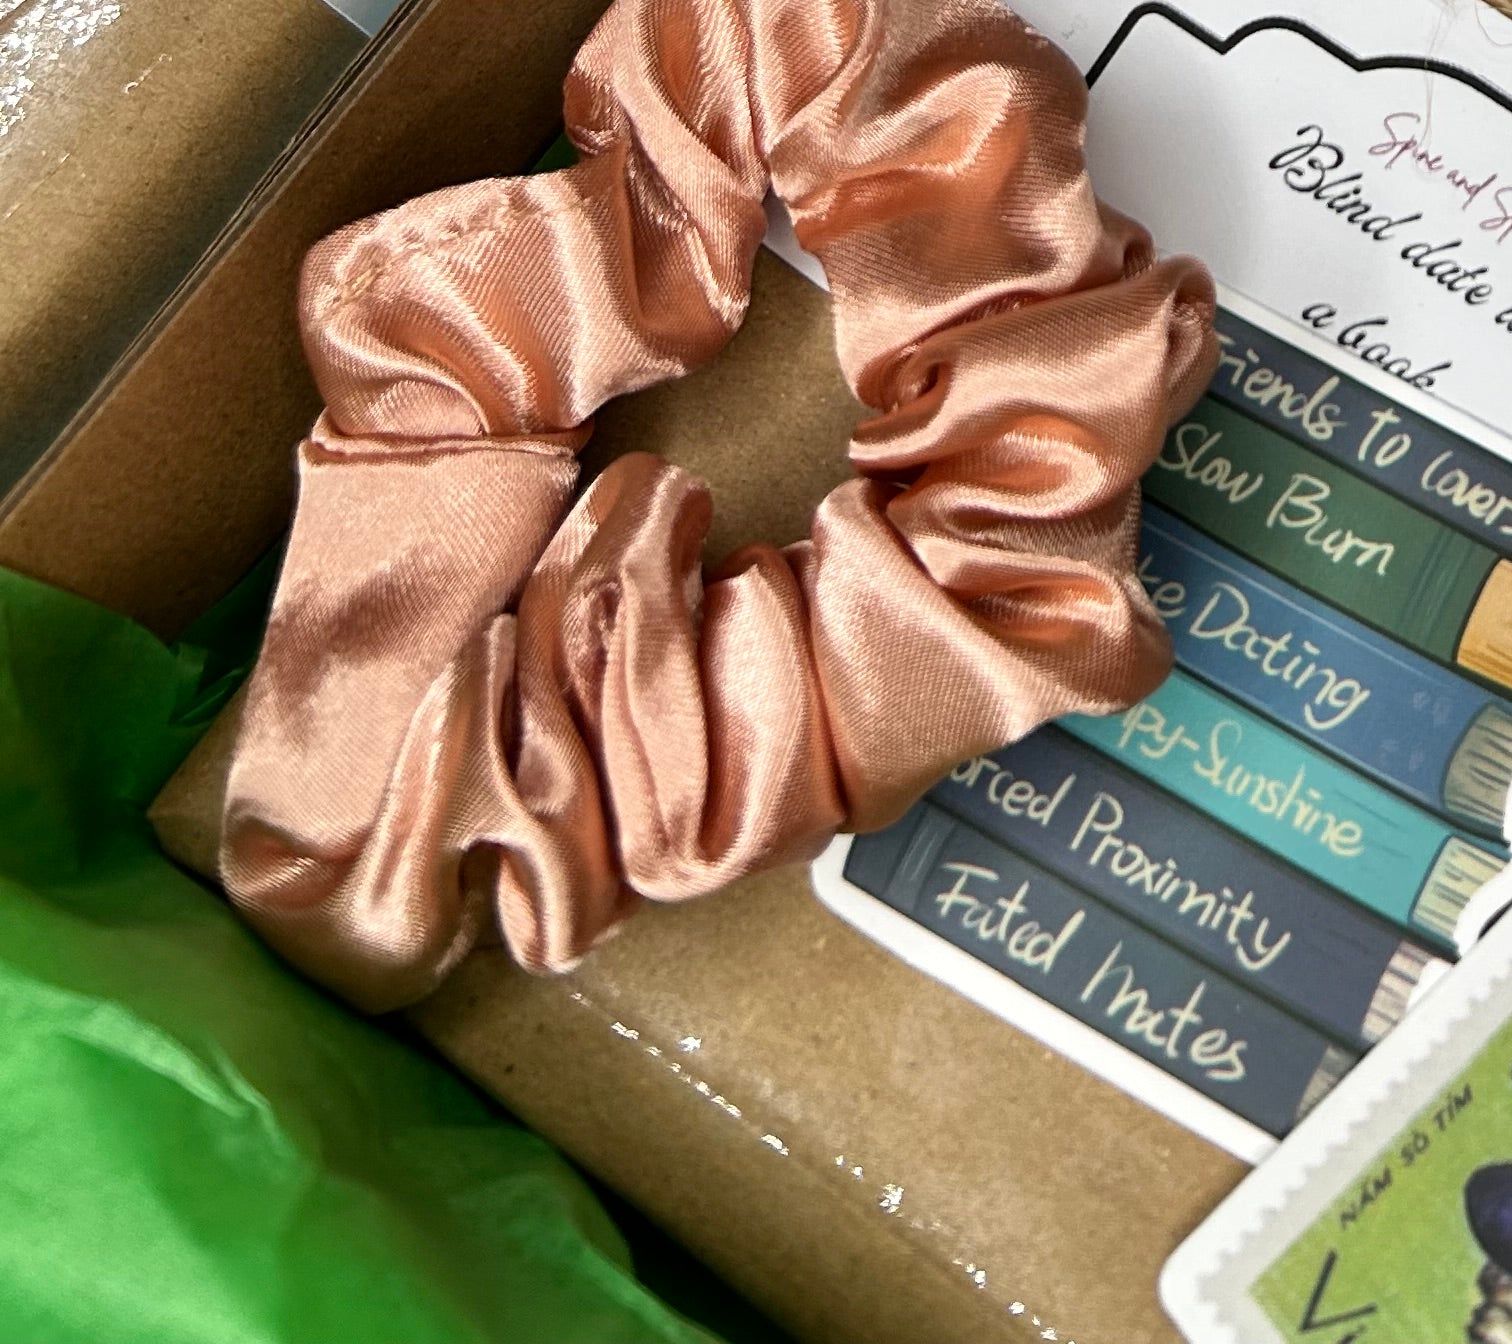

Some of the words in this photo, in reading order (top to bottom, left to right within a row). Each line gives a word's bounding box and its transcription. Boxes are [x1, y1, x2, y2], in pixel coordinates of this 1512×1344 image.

[1269, 125, 1423, 240] Blind
[1400, 239, 1493, 306] date
[1446, 173, 1498, 211] and
[1301, 302, 1338, 328] a
[1337, 317, 1453, 389] book
[1156, 421, 1264, 504] Slow
[1266, 472, 1396, 576] Burn
[1352, 408, 1411, 468] to
[1188, 579, 1373, 732] Dating
[1118, 702, 1366, 859] py-Sunshine
[934, 859, 1088, 976] Fated
[1069, 789, 1296, 973] Proximity
